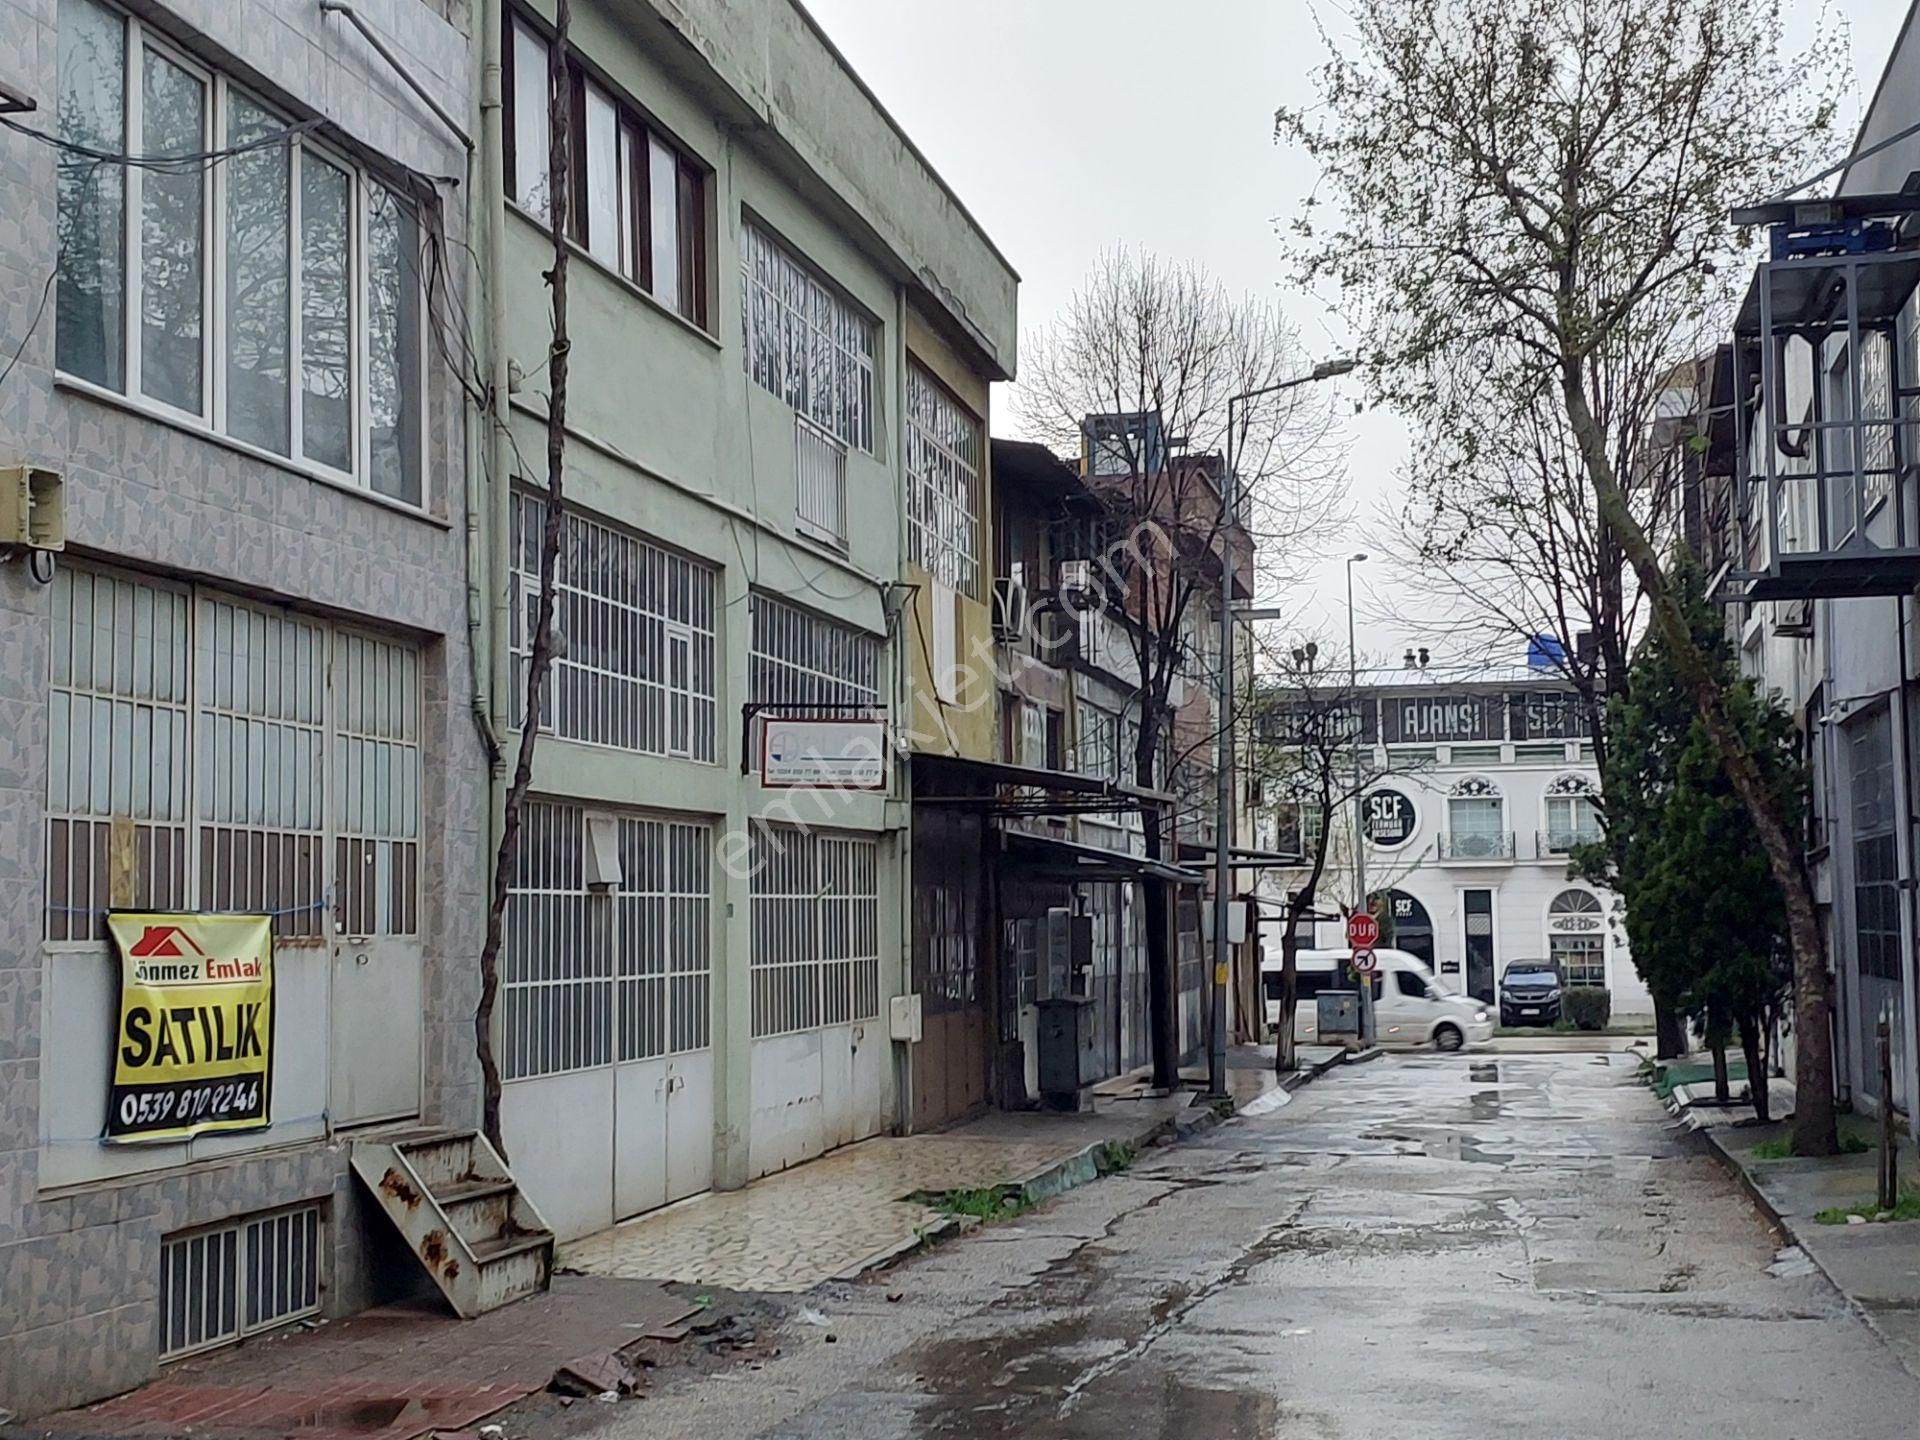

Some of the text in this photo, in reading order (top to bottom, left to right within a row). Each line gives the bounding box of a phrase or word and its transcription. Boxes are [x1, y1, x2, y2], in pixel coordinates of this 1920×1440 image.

[1404, 703, 1480, 735] AJANSI
[1370, 795, 1403, 820] SCF
[1395, 899, 1413, 912] SCF
[1349, 924, 1376, 937] DUR
[205, 956, 262, 980] Emlak
[121, 1001, 262, 1068] SATILIK
[120, 1090, 175, 1126] 0539
